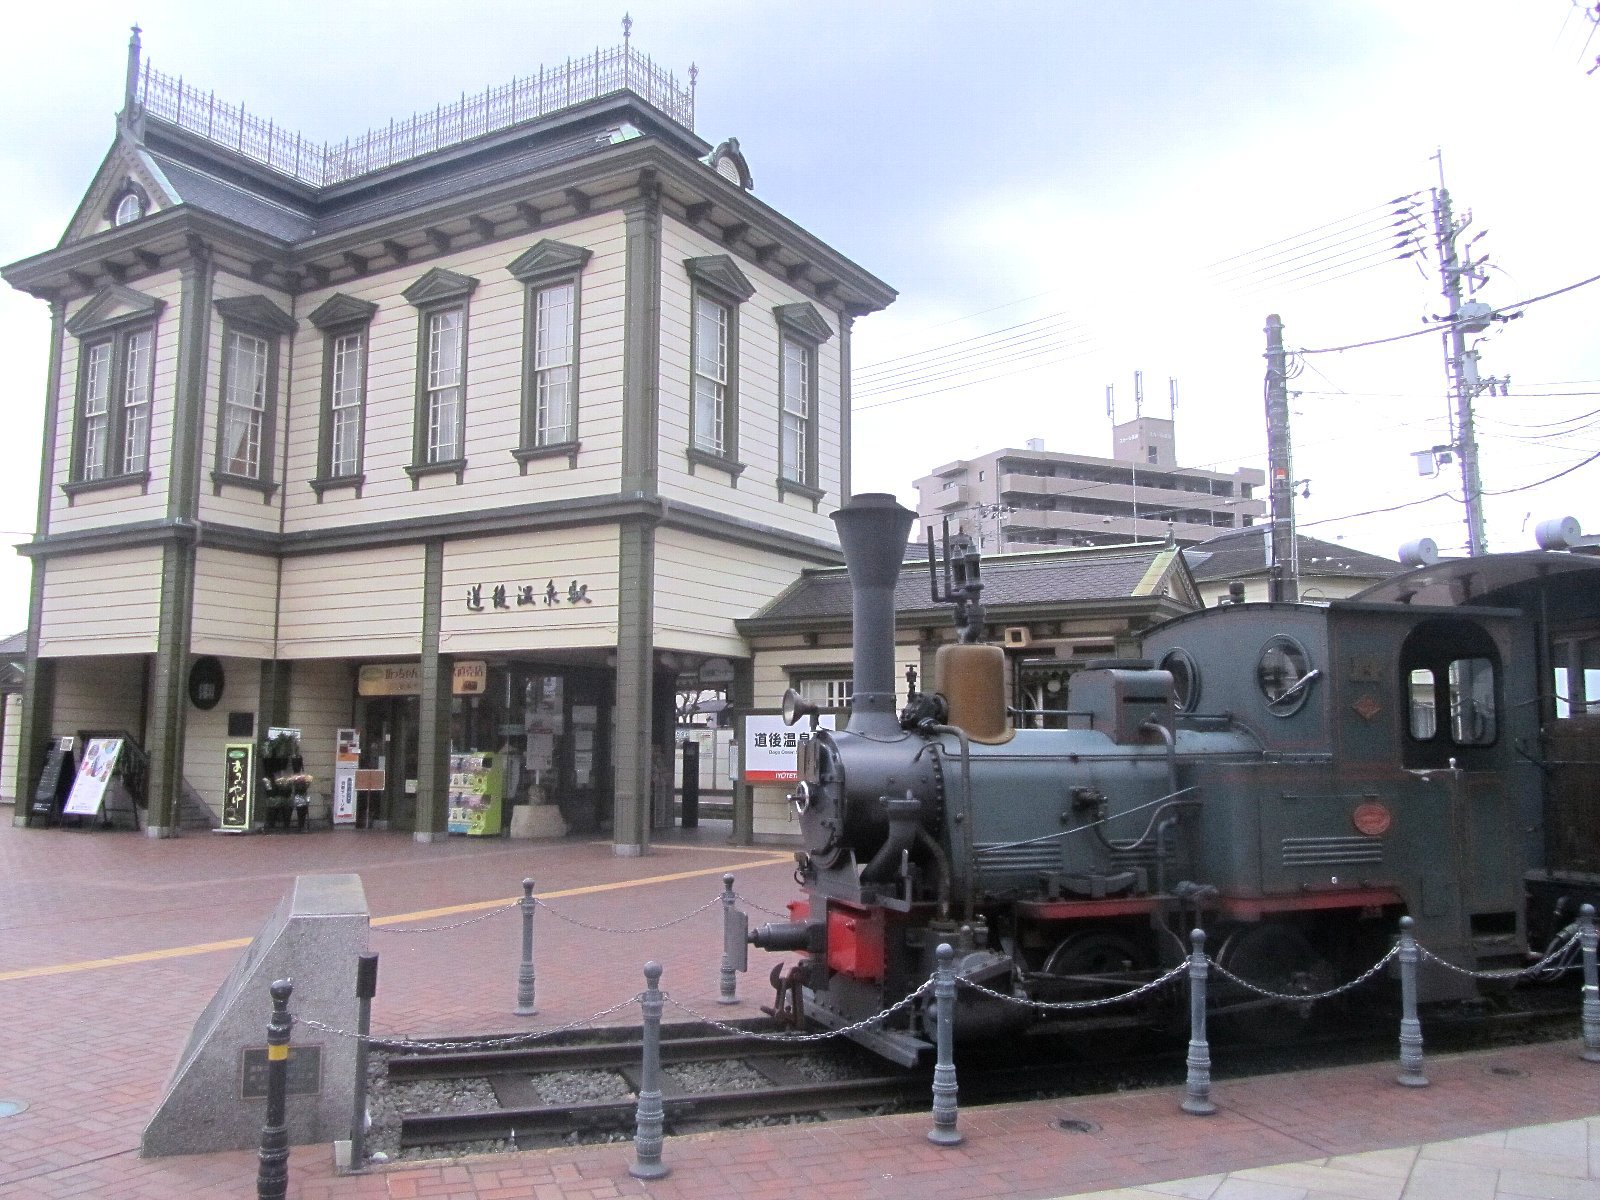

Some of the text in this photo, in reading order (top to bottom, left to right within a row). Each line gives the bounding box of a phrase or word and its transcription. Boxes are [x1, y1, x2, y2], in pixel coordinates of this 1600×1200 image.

[466, 579, 592, 612] 道後温泉駅
